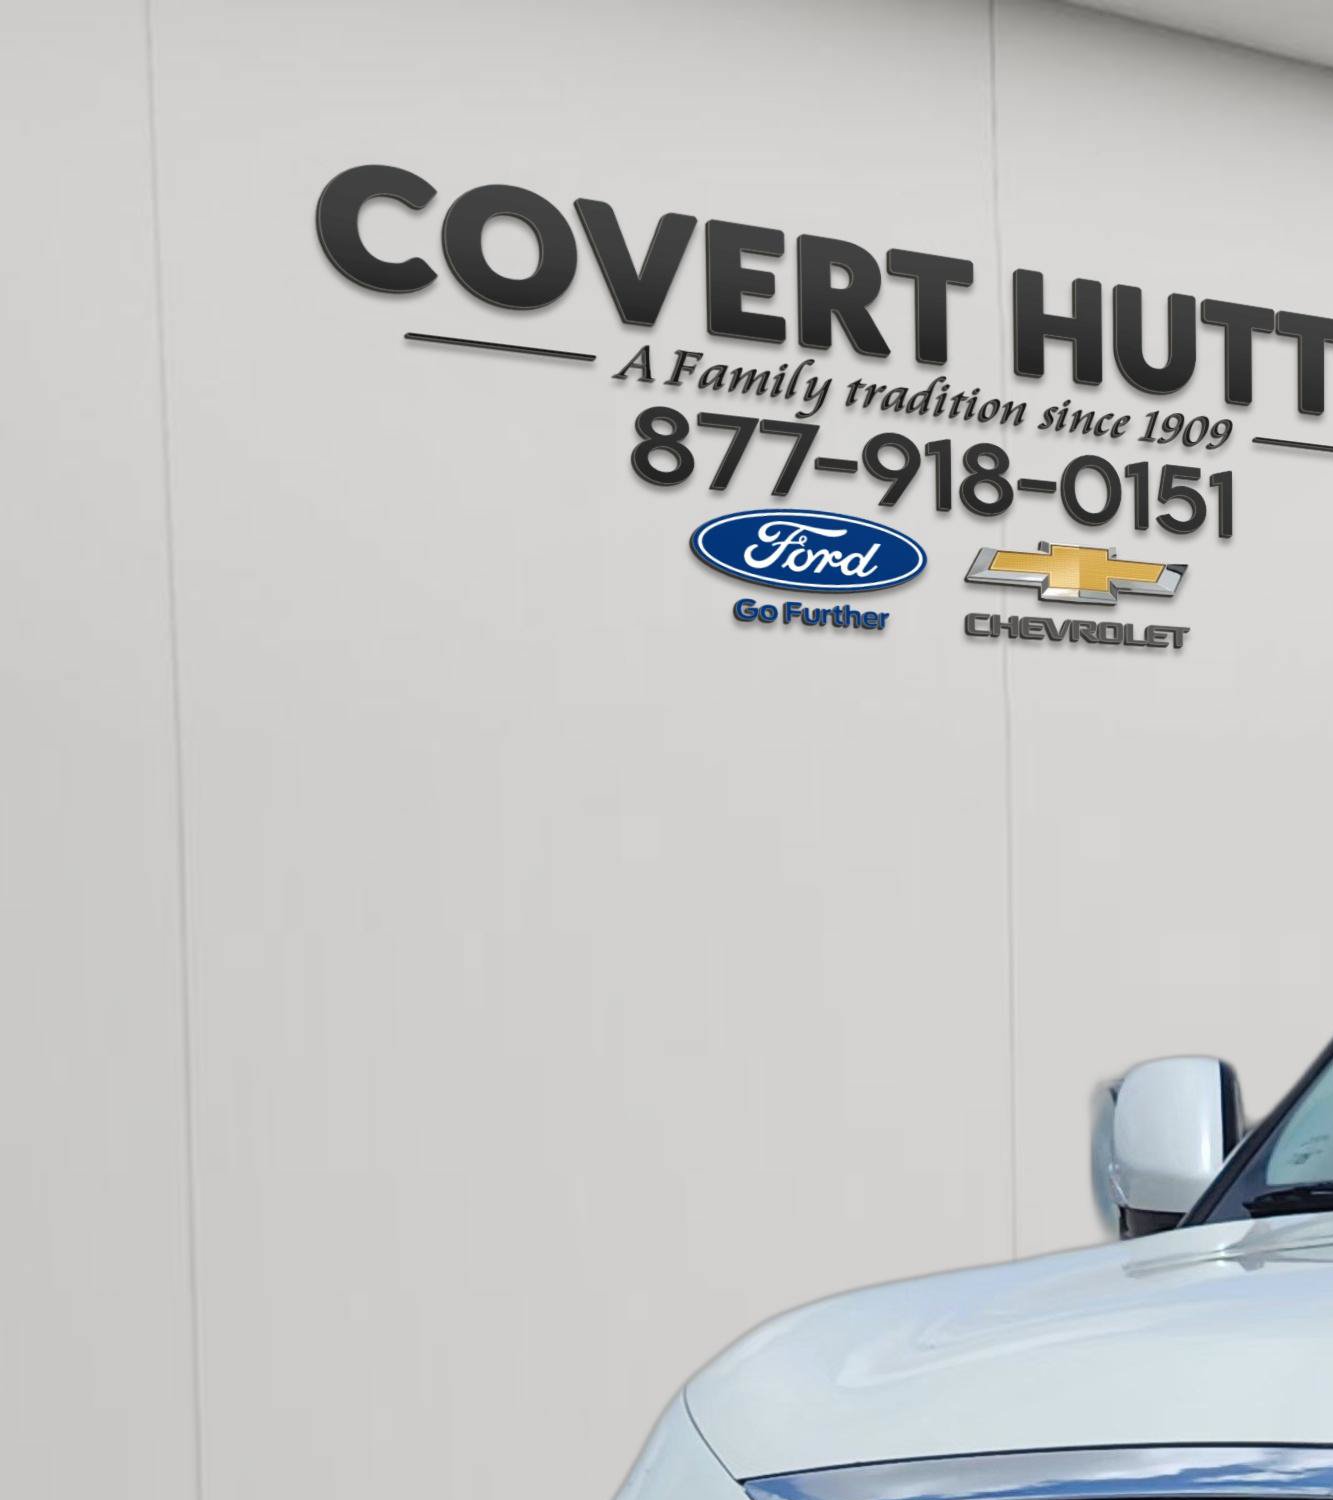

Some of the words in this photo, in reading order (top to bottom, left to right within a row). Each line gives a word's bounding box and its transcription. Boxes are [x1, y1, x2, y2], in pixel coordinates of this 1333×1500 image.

[316, 165, 975, 367] COVERT
[612, 345, 655, 384] A
[664, 349, 833, 420] Family
[846, 376, 1027, 427] tradition
[1037, 399, 1131, 439] since
[1138, 410, 1234, 450] 1909
[630, 406, 1234, 540] 877-918-0151
[742, 520, 882, 579] Ford
[733, 599, 778, 625] Go
[783, 601, 890, 631] Further
[964, 613, 1191, 650] CHEVROLET
